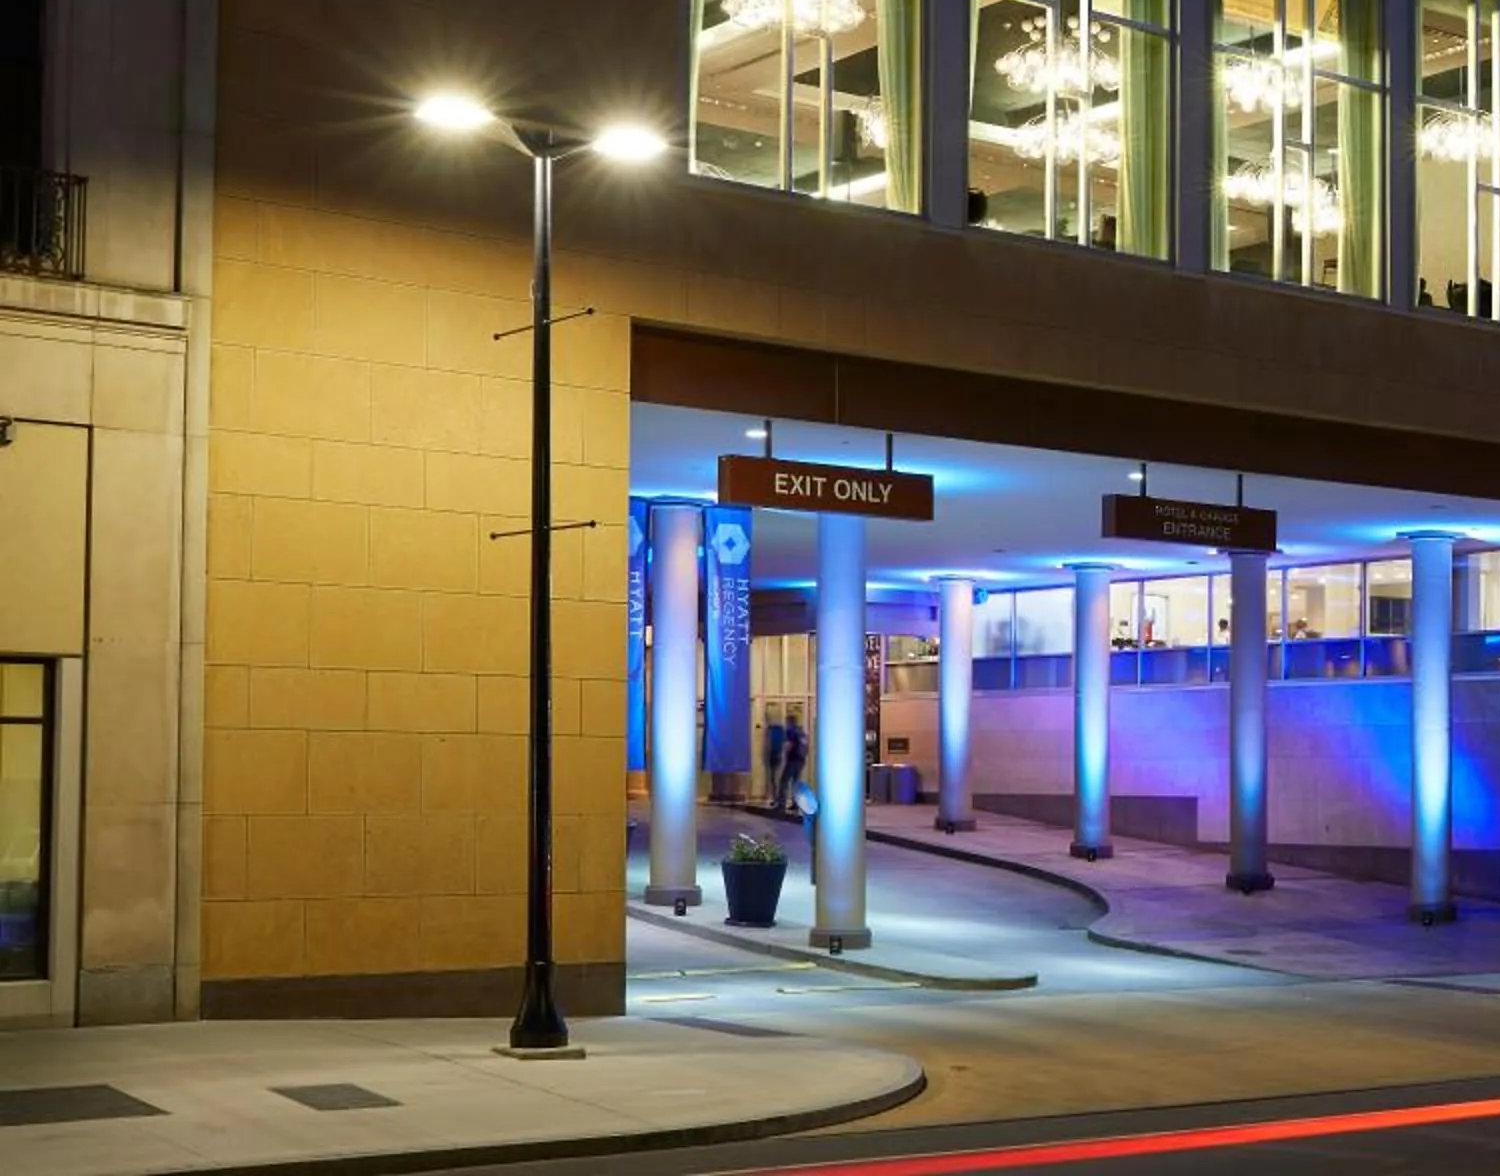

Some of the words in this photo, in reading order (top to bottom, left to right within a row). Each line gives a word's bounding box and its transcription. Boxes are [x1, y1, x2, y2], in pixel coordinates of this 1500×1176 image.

[774, 473, 827, 498] EXIT
[833, 479, 893, 504] ONLY
[1163, 521, 1232, 541] ENTRANCE
[629, 571, 643, 639] HYATT
[723, 577, 738, 665] REGENCY
[737, 579, 750, 645] HYATT
